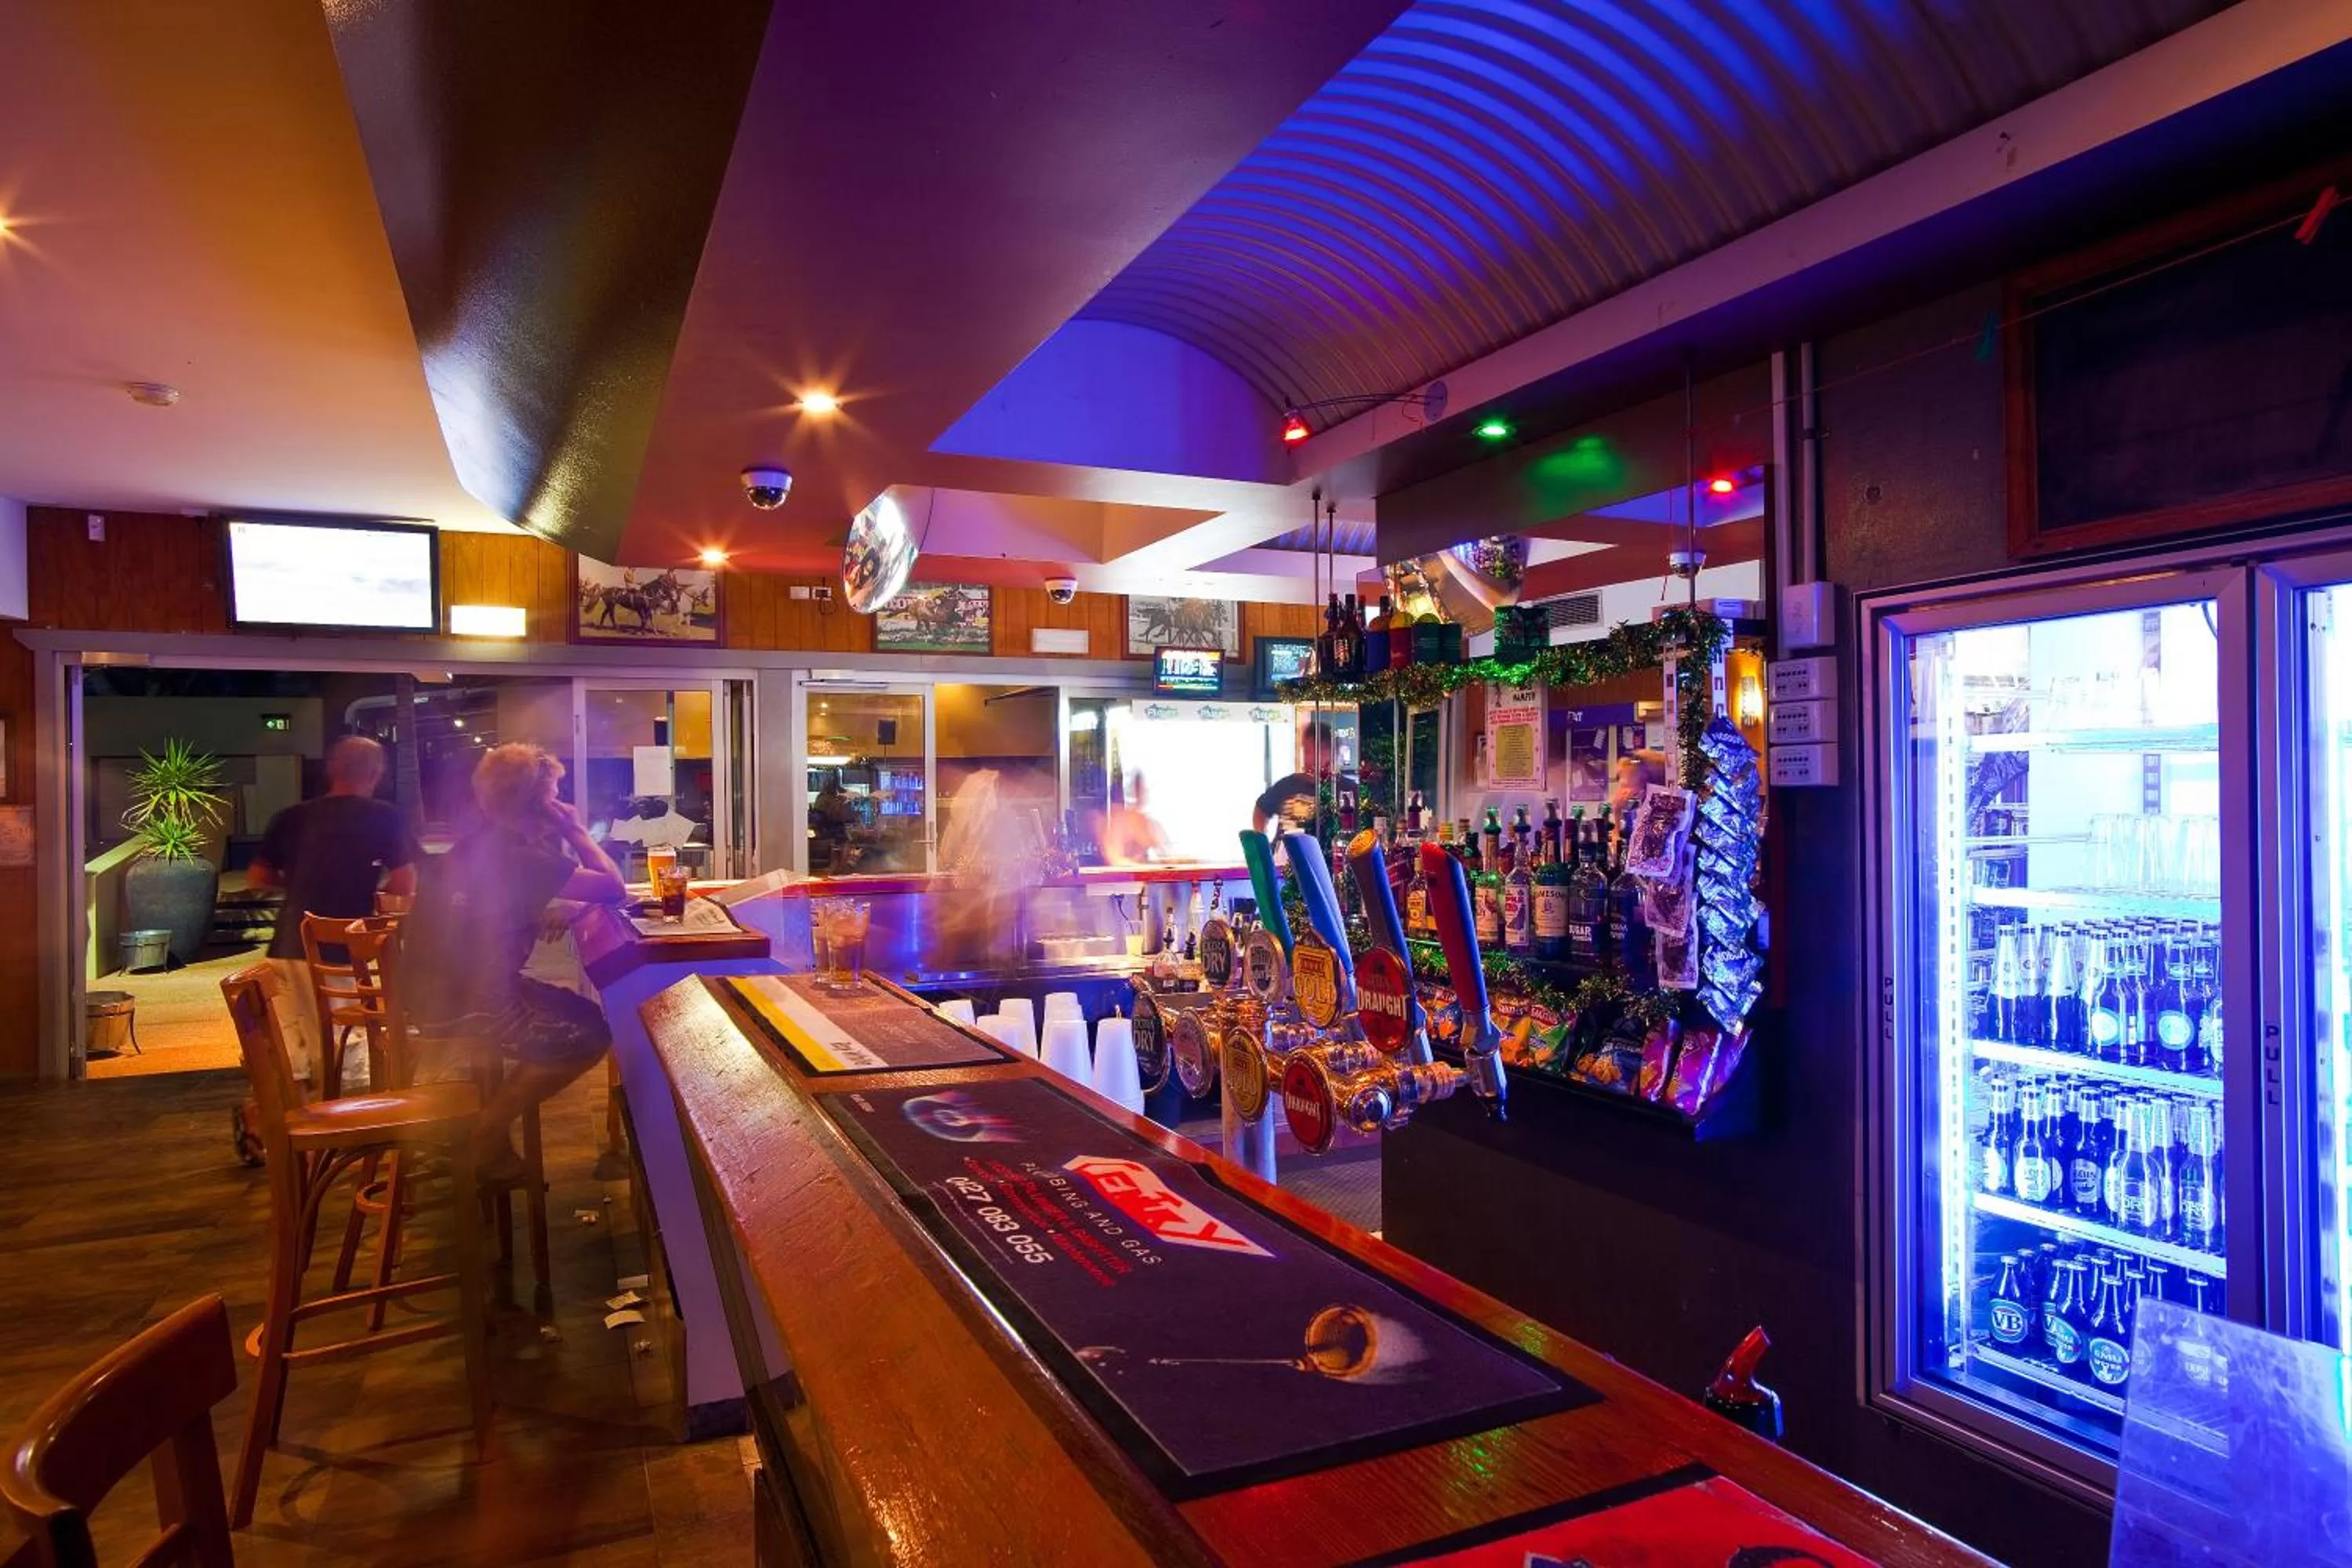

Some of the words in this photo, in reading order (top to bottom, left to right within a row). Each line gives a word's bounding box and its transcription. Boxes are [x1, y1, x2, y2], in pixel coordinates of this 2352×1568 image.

[1203, 952, 1226, 973] DRY
[1357, 987, 1410, 1022] DRAUGHT
[1884, 977, 1893, 1040] PULL
[1133, 1030, 1155, 1051] DRY
[2266, 1025, 2279, 1105] PULL
[978, 1206, 1020, 1233] 083
[1006, 1234, 1055, 1265] 055
[1085, 1211, 1123, 1236] AND
[1121, 1239, 1163, 1265] GAS
[1993, 1311, 2023, 1331] VB
